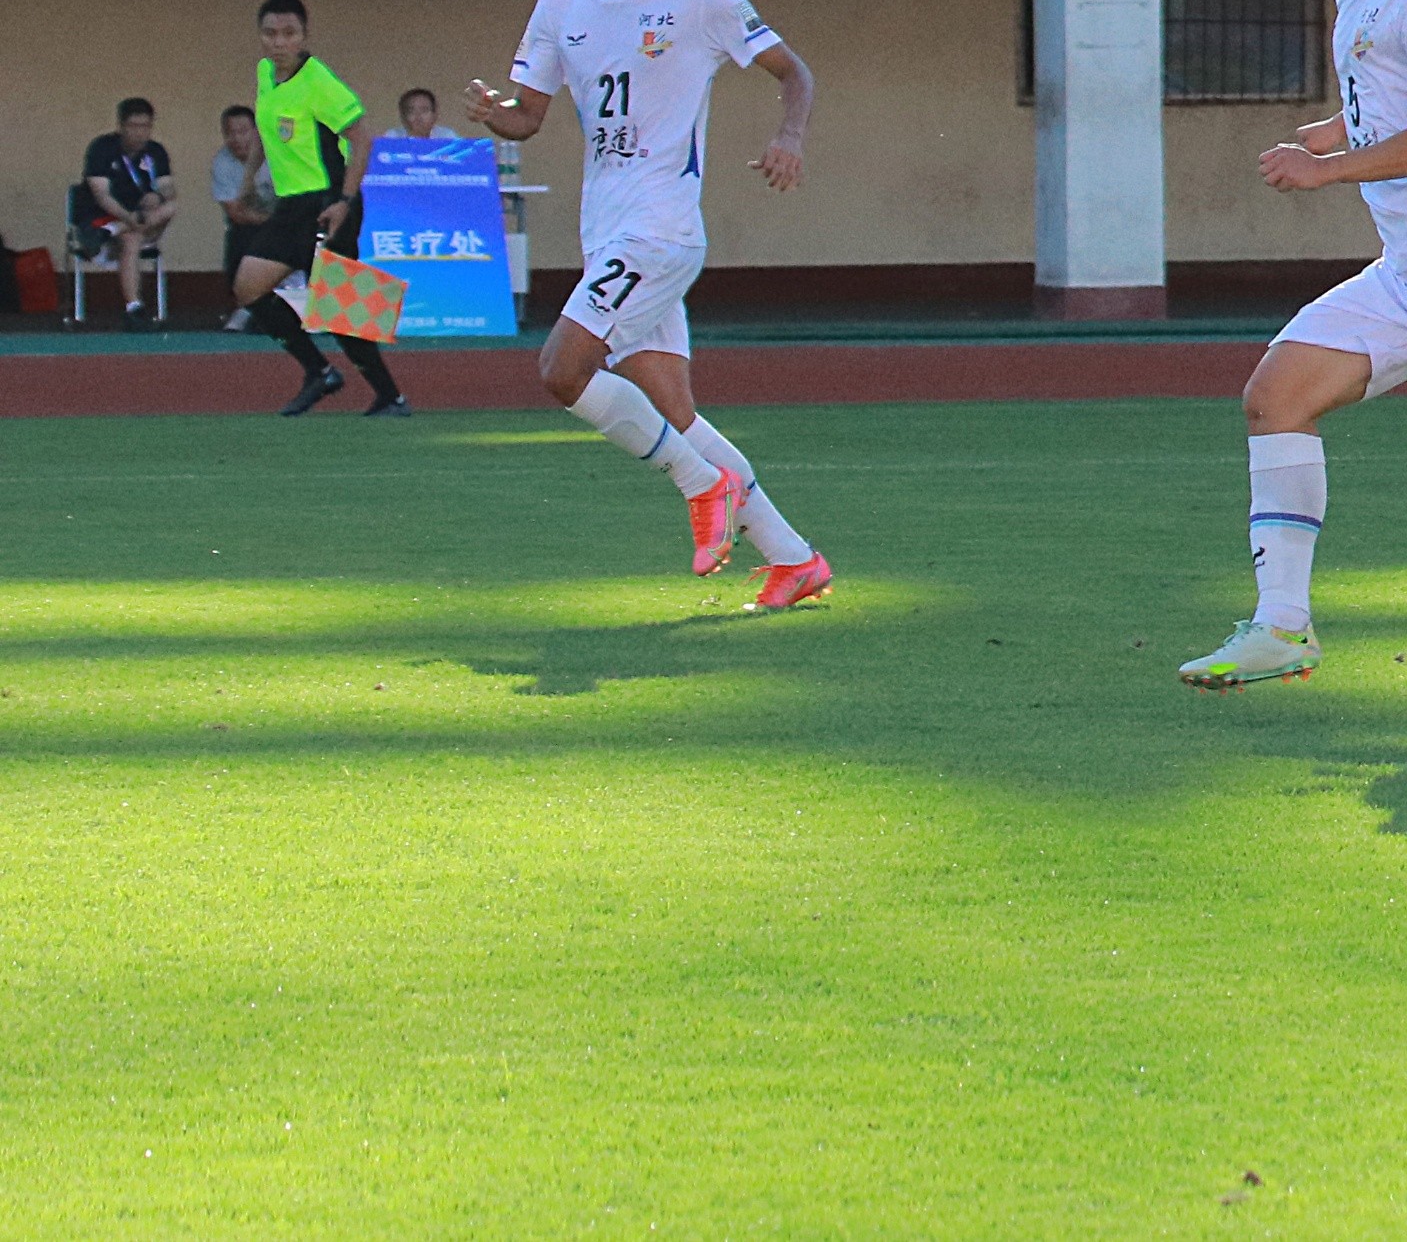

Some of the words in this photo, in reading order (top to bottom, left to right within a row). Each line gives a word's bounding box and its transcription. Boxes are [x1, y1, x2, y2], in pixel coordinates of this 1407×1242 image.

[599, 71, 630, 118] 21
[372, 229, 485, 258] 医疗处
[587, 258, 642, 311] 21
